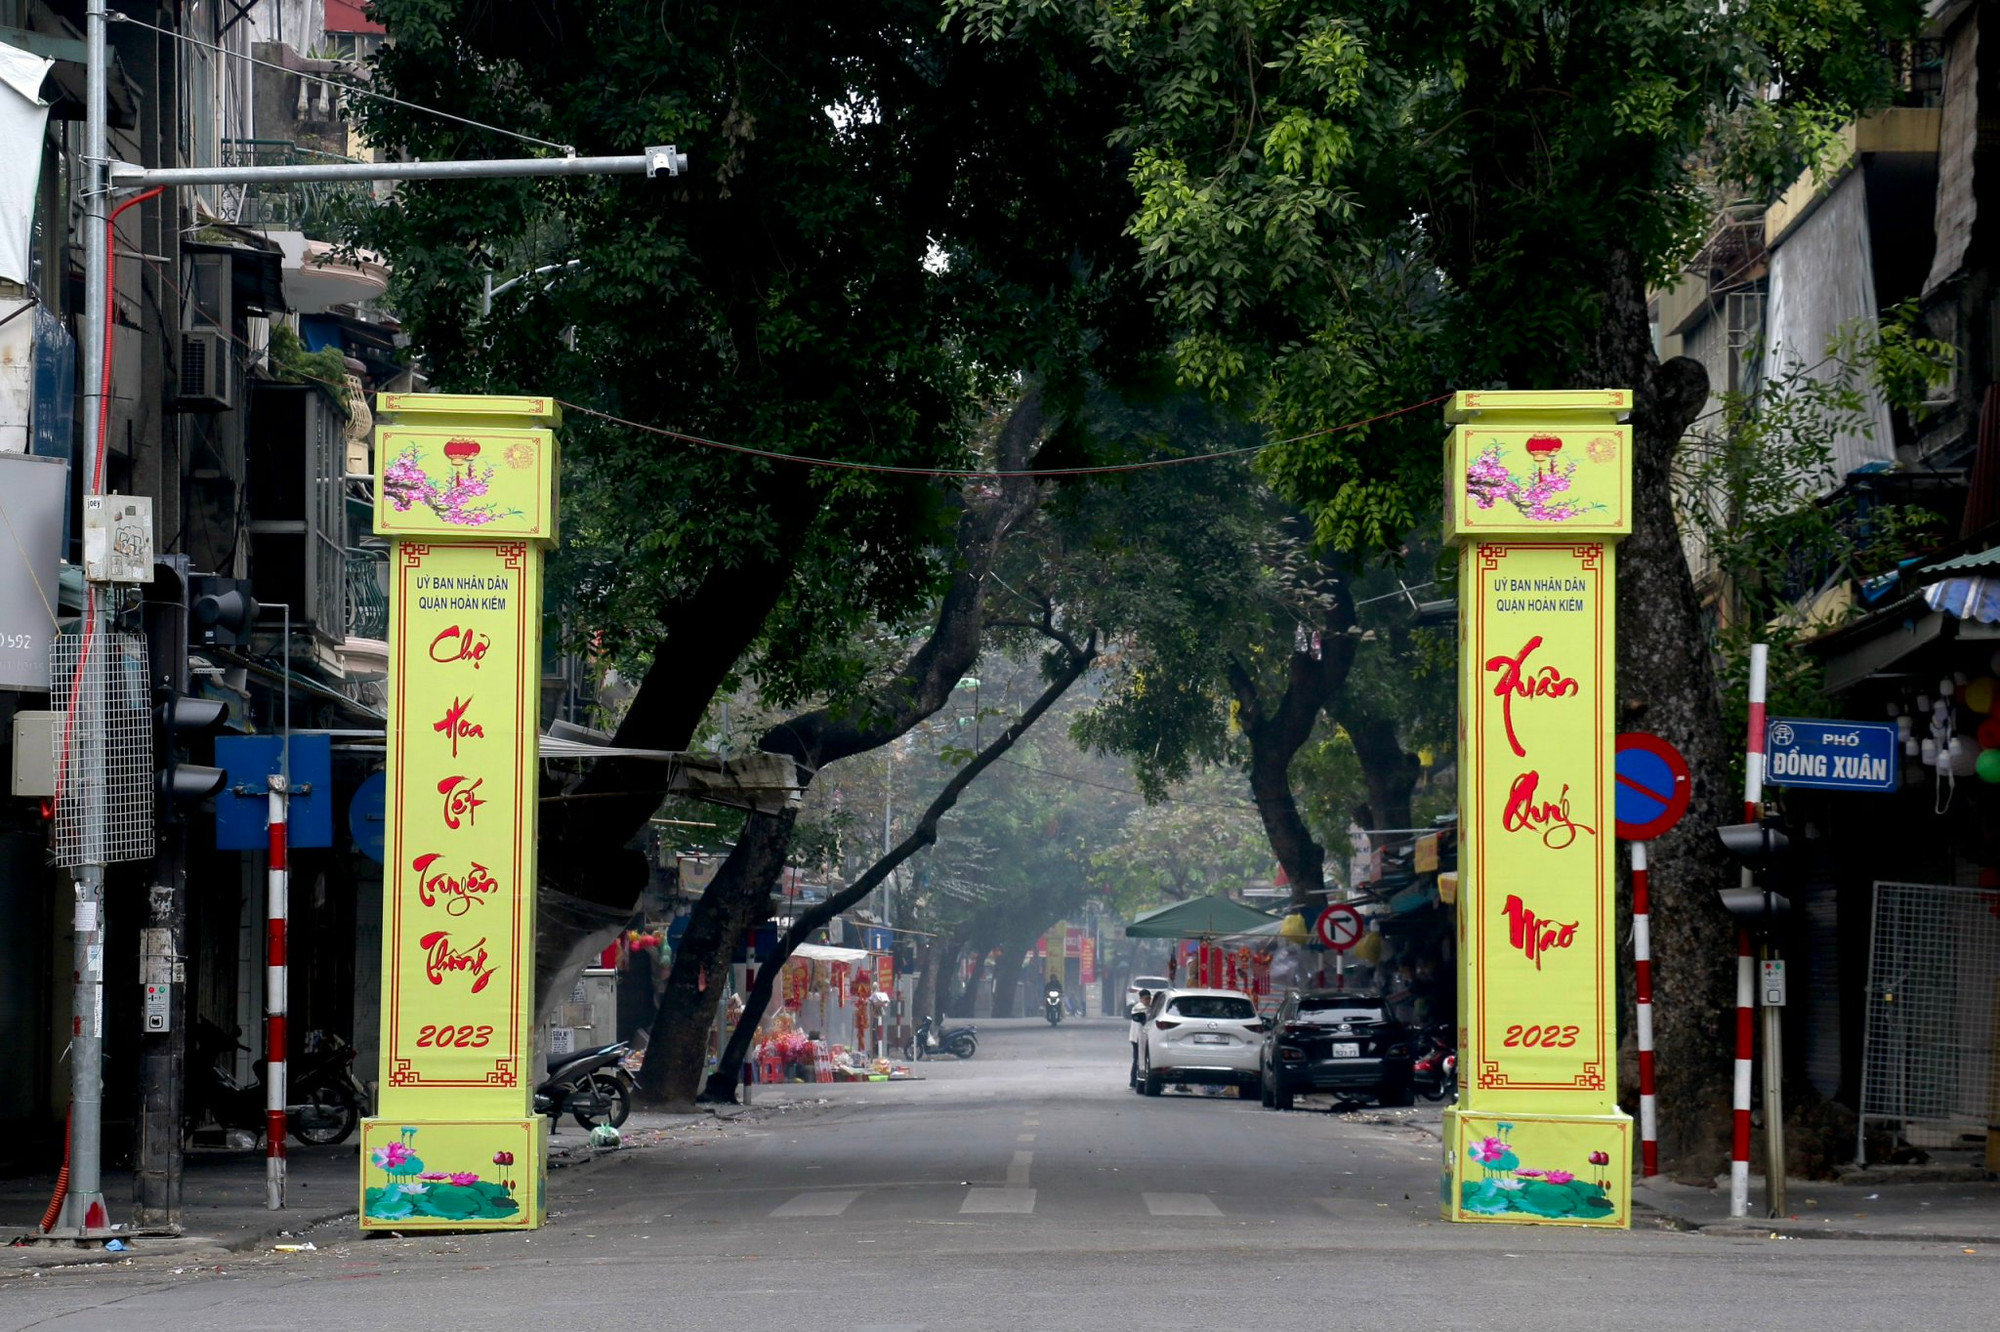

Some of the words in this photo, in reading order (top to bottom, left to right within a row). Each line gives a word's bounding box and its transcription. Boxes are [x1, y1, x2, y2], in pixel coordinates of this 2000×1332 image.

[87, 498, 101, 509] joey
[432, 577, 454, 590] BAN
[456, 574, 485, 590] NHÂN
[487, 575, 509, 591] DÂN
[1510, 579, 1531, 592] BAN
[1534, 576, 1562, 592] NHÂN
[1565, 576, 1586, 592] DÂN
[418, 596, 448, 612] QUẬN
[450, 594, 479, 610] HOÀN
[481, 595, 506, 610] KIẾM
[1496, 598, 1525, 614] QUẬN
[1527, 596, 1556, 612] HOÀN
[1559, 596, 1583, 612] KIẾM
[429, 624, 490, 669] Chợ
[1485, 635, 1579, 757] Xuân
[433, 694, 485, 758] Hoa
[1822, 730, 1861, 747] PHỐ
[1773, 746, 1828, 777] ĐỒNG
[1831, 753, 1888, 781] XUÂN
[437, 776, 487, 830] Tết
[1502, 770, 1596, 850] Quý
[412, 853, 499, 916] Truyền
[1501, 894, 1580, 971] Mão
[420, 930, 501, 994] Thống
[416, 1024, 494, 1049] 2023
[1503, 1024, 1581, 1049] 2023
